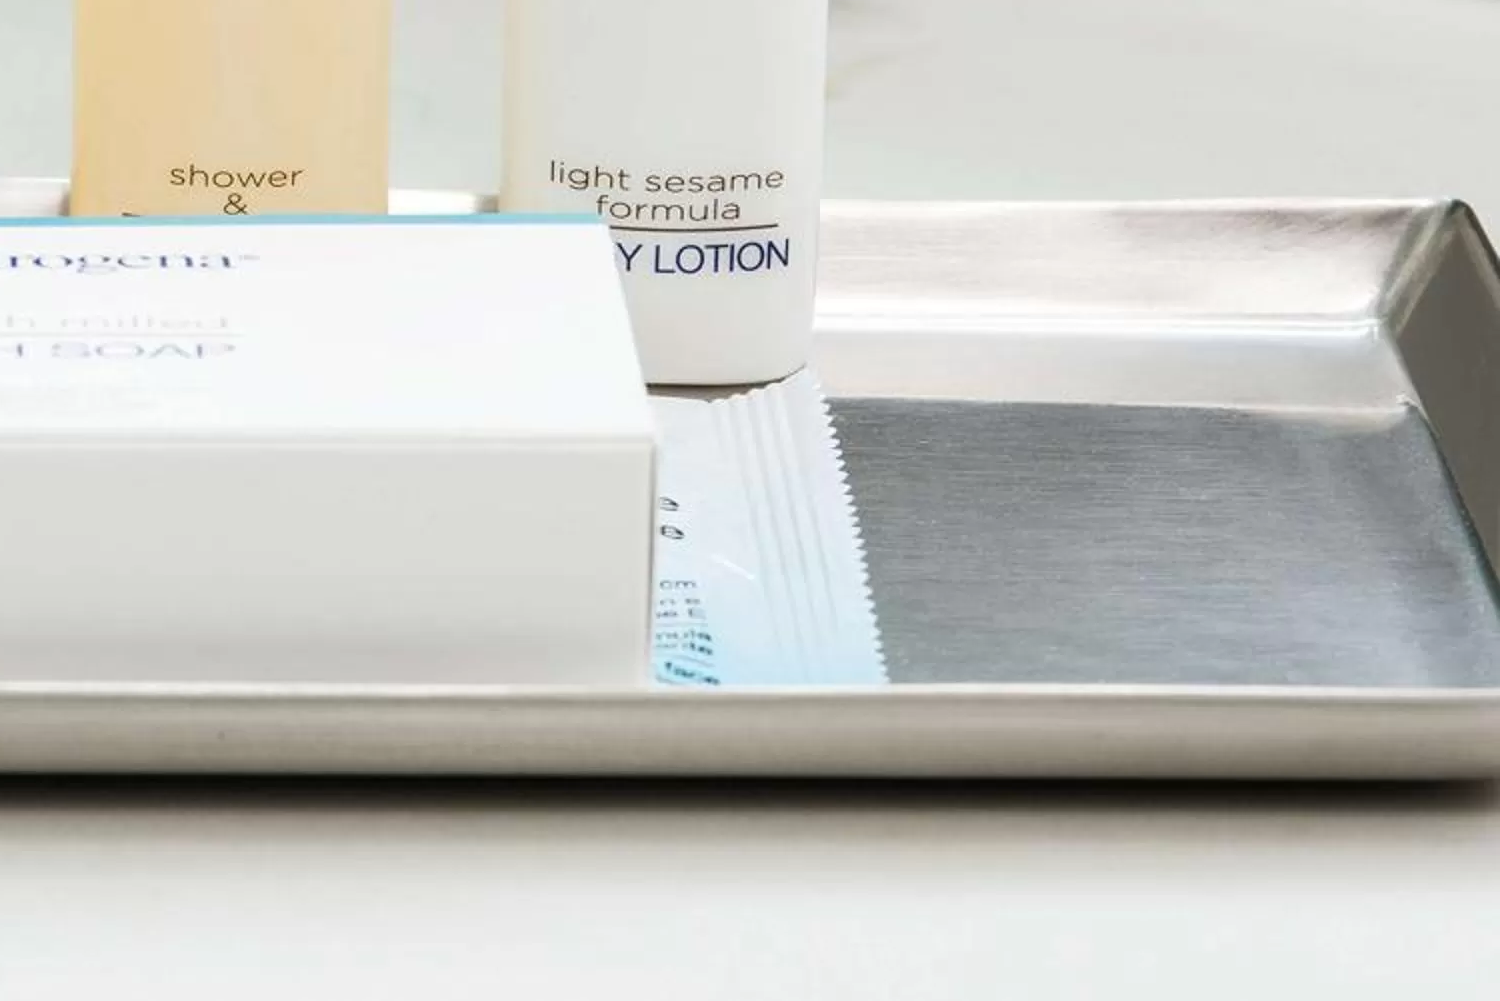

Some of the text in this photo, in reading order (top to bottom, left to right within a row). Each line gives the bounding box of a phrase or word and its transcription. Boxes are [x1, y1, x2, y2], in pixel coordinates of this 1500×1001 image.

[169, 164, 304, 188] shower
[549, 159, 785, 194] light sesame
[223, 193, 248, 215] &
[596, 193, 741, 222] formula
[654, 238, 790, 274] LOTION
[52, 342, 236, 359] SOAP
